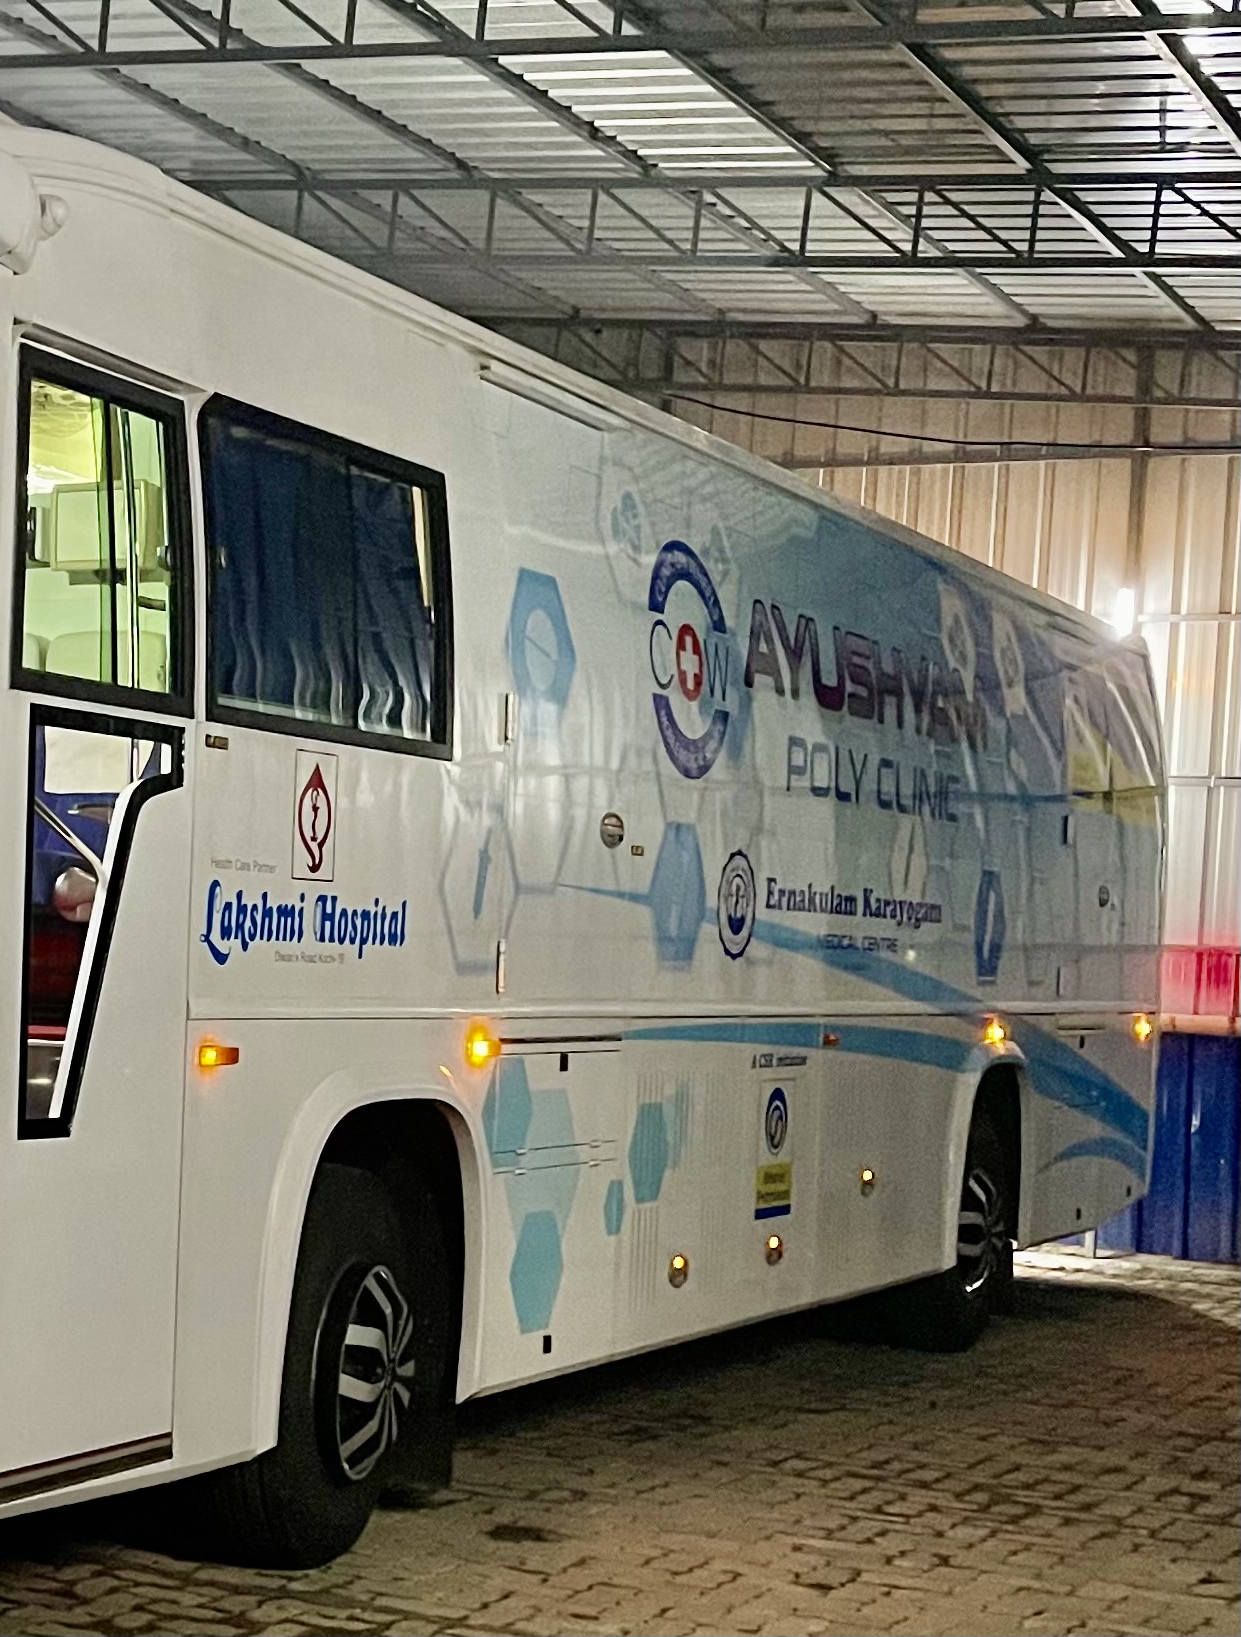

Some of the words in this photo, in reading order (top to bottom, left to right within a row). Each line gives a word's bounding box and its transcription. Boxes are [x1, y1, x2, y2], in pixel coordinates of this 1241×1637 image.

[744, 598, 988, 752] AYUSHYAM
[787, 735, 868, 804] POLY
[876, 757, 960, 823] CLINIC
[199, 879, 305, 966] Lakshmi
[314, 894, 408, 960] Hospital
[765, 877, 858, 917] Ernakulam
[862, 888, 943, 929] Karayogam
